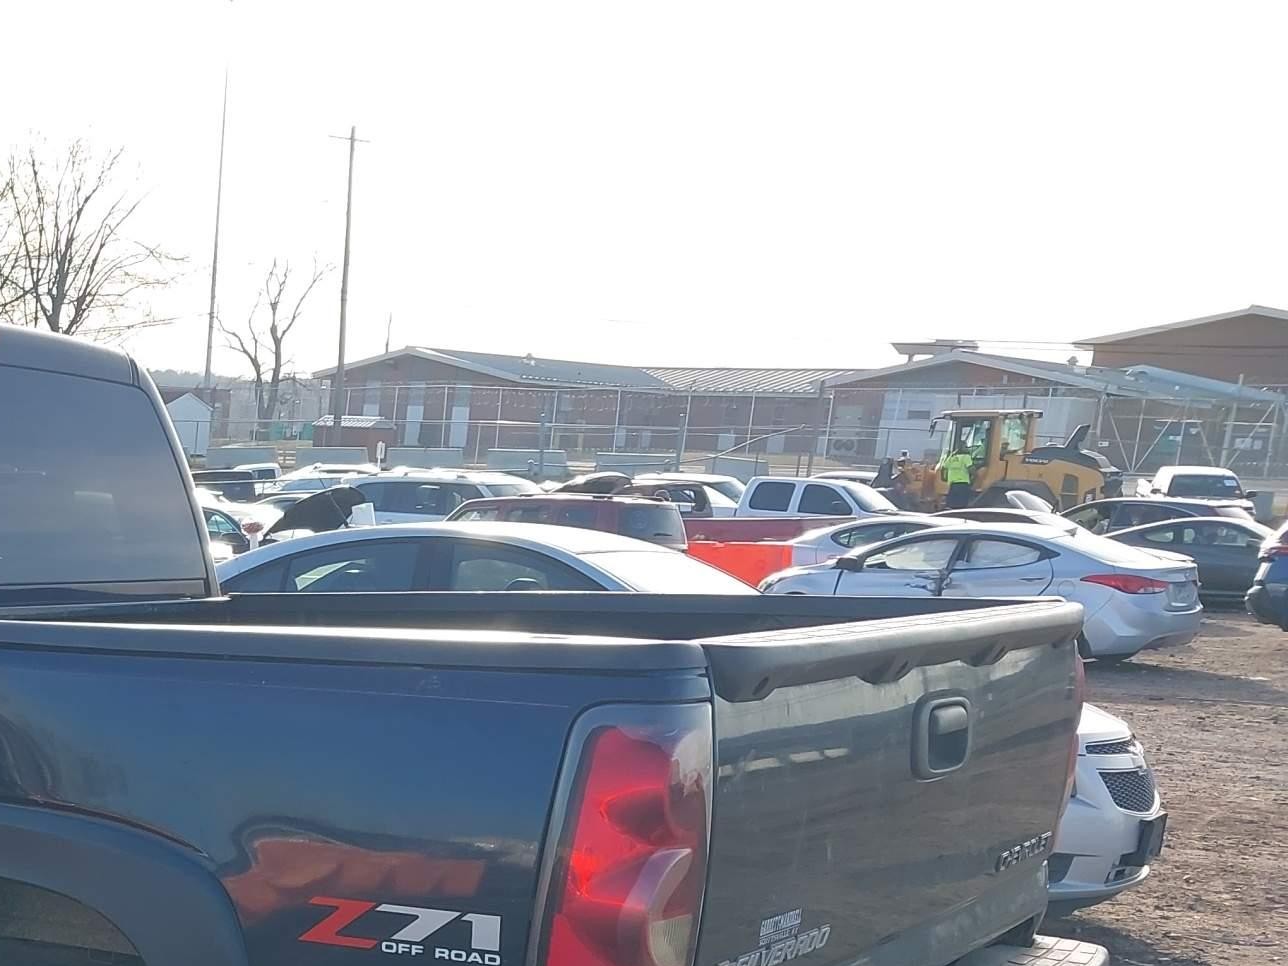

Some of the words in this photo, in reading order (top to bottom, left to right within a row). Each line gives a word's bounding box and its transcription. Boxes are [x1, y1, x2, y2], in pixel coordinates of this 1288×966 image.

[297, 896, 502, 952] Z71
[381, 940, 425, 956] OFF
[434, 946, 501, 966] ROAD
